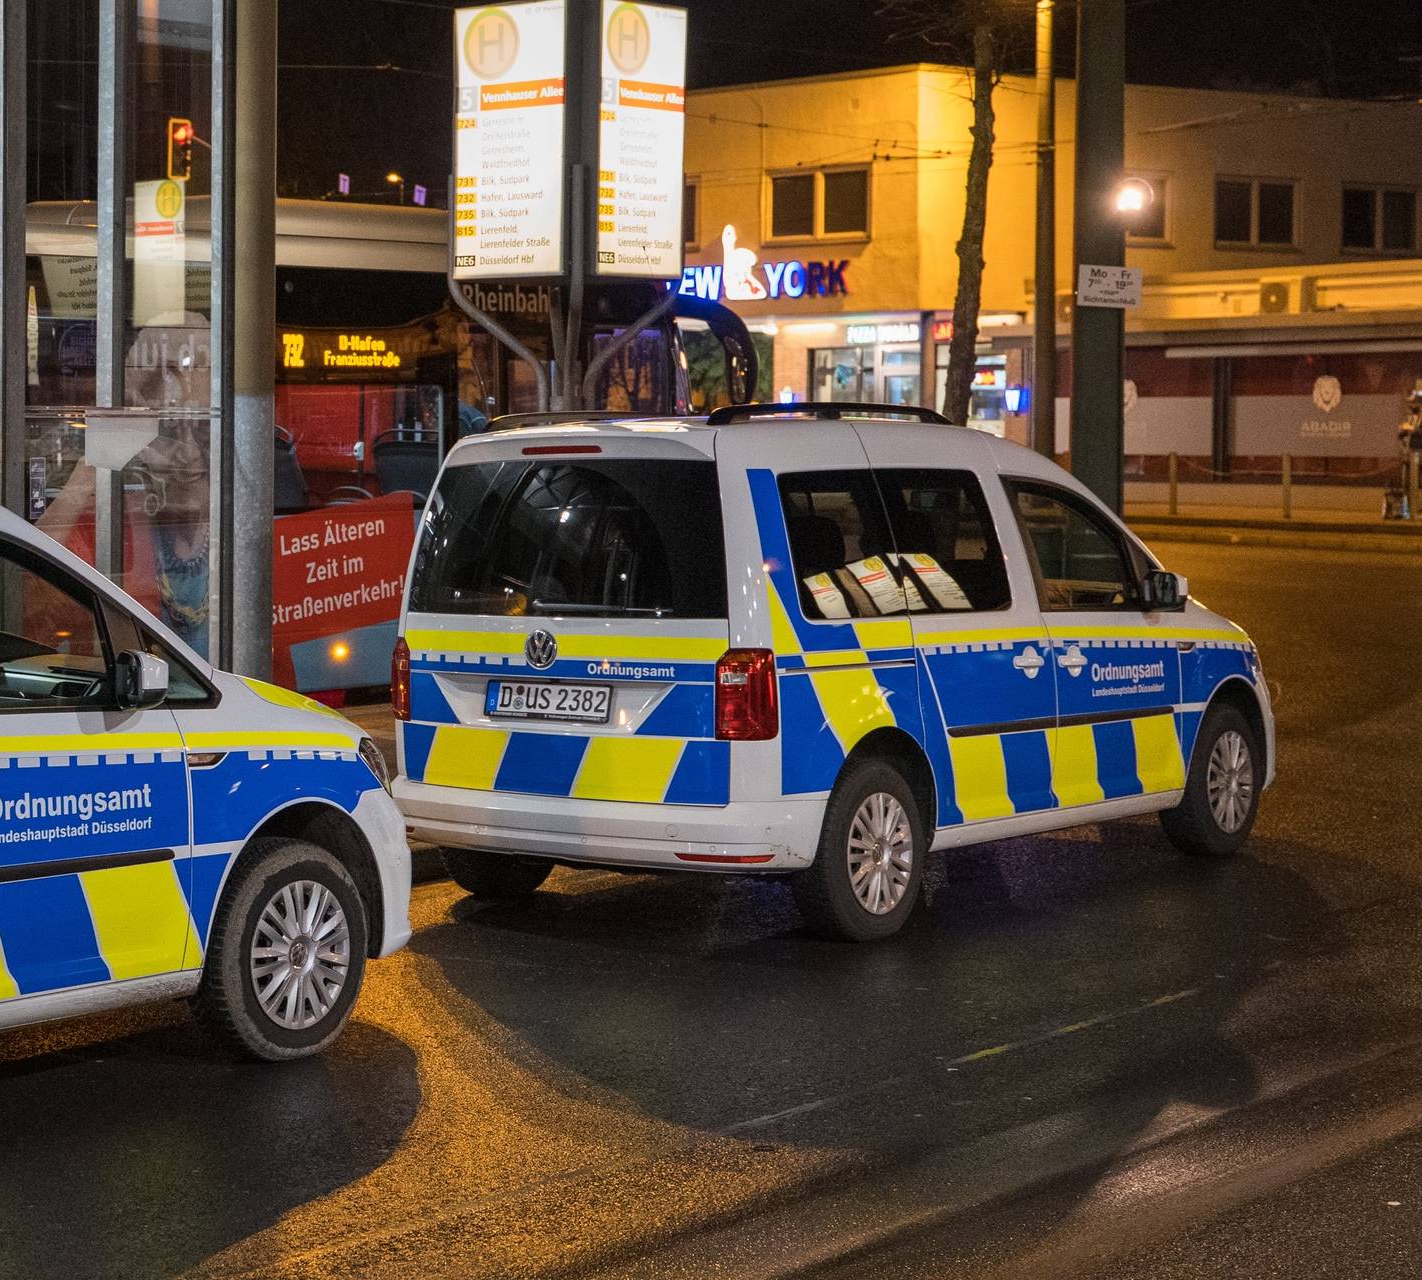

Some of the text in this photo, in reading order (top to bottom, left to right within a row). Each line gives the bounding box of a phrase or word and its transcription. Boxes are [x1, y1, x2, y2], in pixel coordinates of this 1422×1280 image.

[482, 86, 564, 103] Vennhauser Allee
[458, 177, 474, 187] 731
[499, 174, 530, 186] Südpark
[458, 193, 474, 203] 732
[458, 210, 474, 219] 735
[499, 207, 529, 219] Südpark
[600, 205, 614, 214] 735
[458, 224, 518, 236] 815 Lierenfeld,
[600, 222, 613, 232] 815
[480, 236, 550, 249] Lierenfelder Straße
[457, 254, 535, 267] NE6 Düsseldorf Hbf
[600, 252, 614, 262] NE6
[678, 259, 850, 300] EW YORK
[1091, 268, 1107, 278] Mo
[1121, 270, 1132, 279] Fr
[462, 283, 552, 313] Rheinbah
[283, 333, 304, 367] 732
[339, 334, 386, 351] D-Hafen
[323, 350, 401, 367] Franziusstraße
[280, 519, 385, 556] Lass Älteren
[306, 555, 364, 583] Zeit im
[587, 662, 675, 678] Ordnungsamt
[1091, 660, 1164, 683] Ordnungsamt
[499, 686, 607, 713] D US 2382
[91, 816, 152, 835] Düsseldorf
